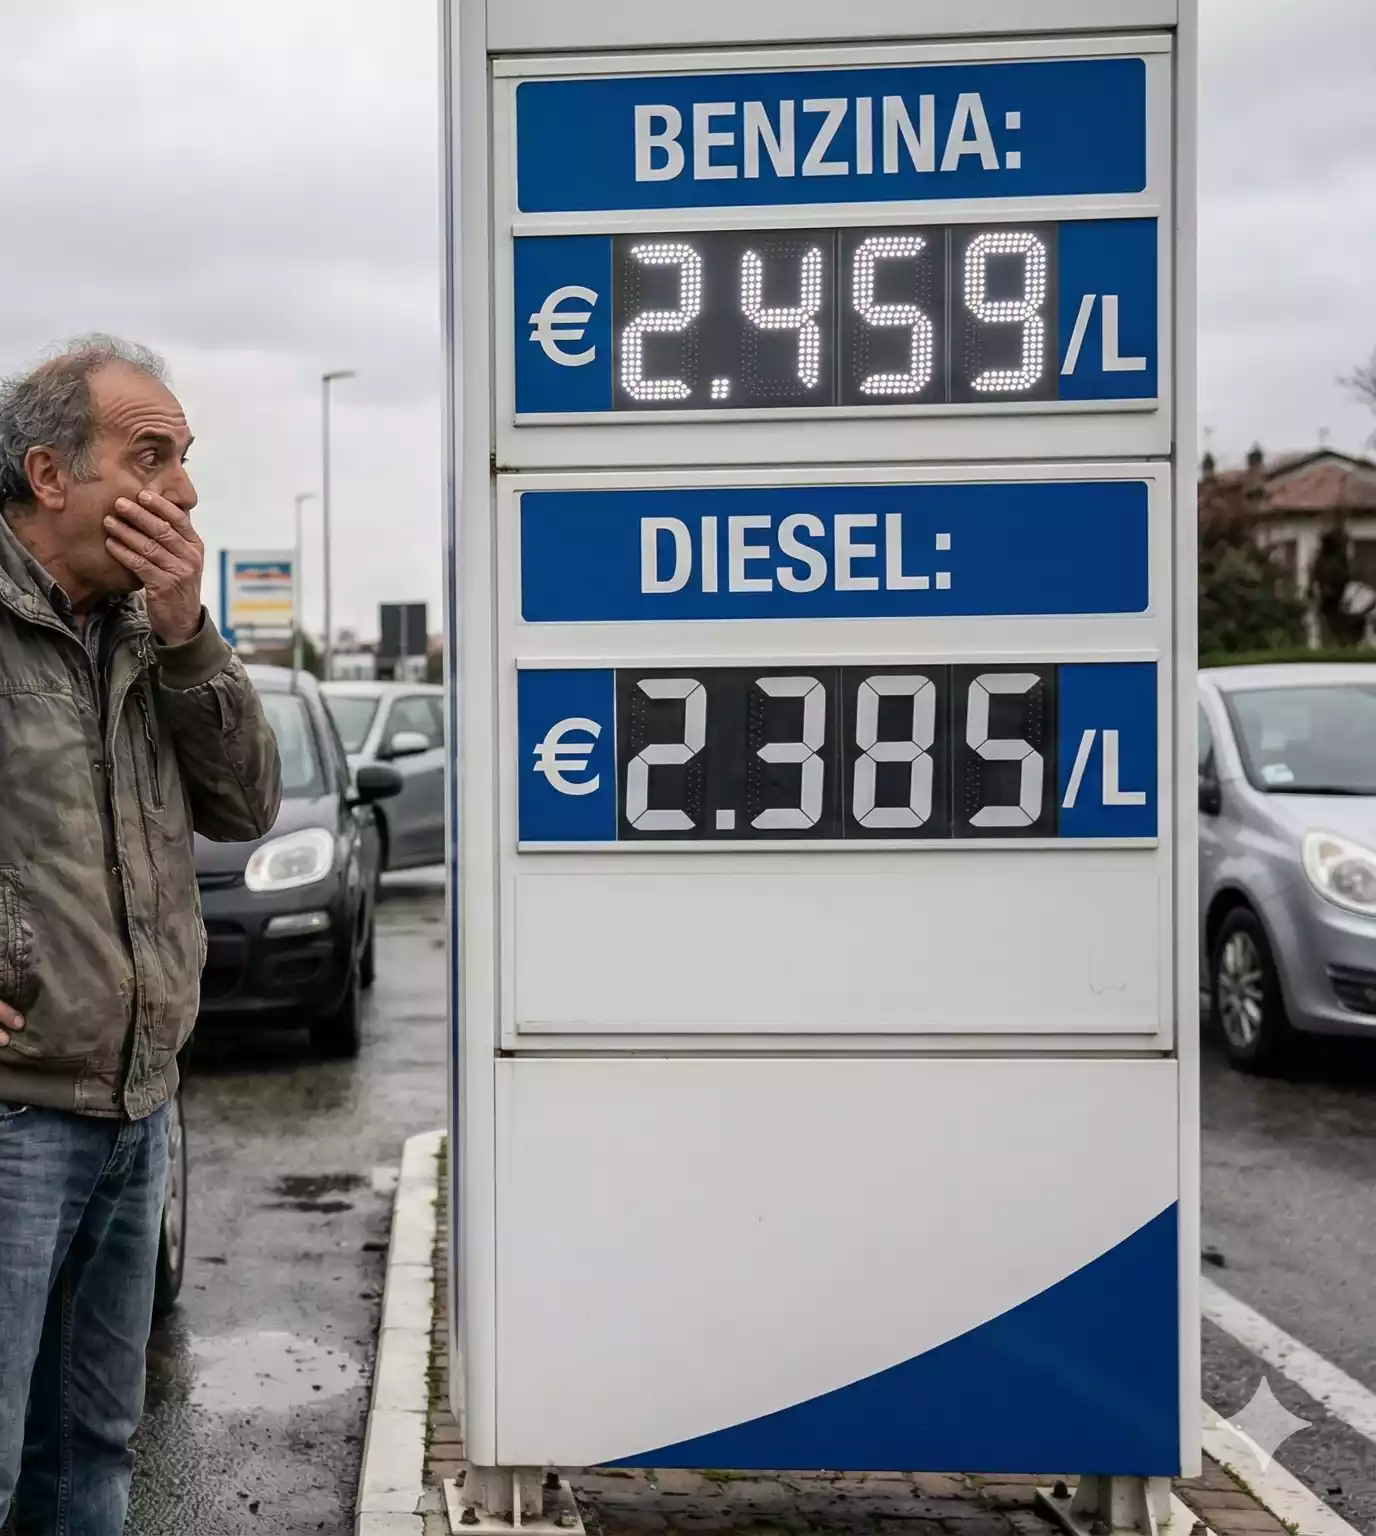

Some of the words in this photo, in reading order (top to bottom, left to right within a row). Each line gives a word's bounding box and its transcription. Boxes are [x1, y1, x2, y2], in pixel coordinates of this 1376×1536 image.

[634, 92, 1021, 182] BENZINA:
[528, 285, 599, 367] €
[619, 231, 1049, 402] 2.459
[1060, 294, 1147, 375] /L
[640, 513, 951, 594] DIESEL:
[532, 717, 602, 796] €
[625, 672, 1044, 831] 2.385
[1062, 729, 1146, 808] /L
